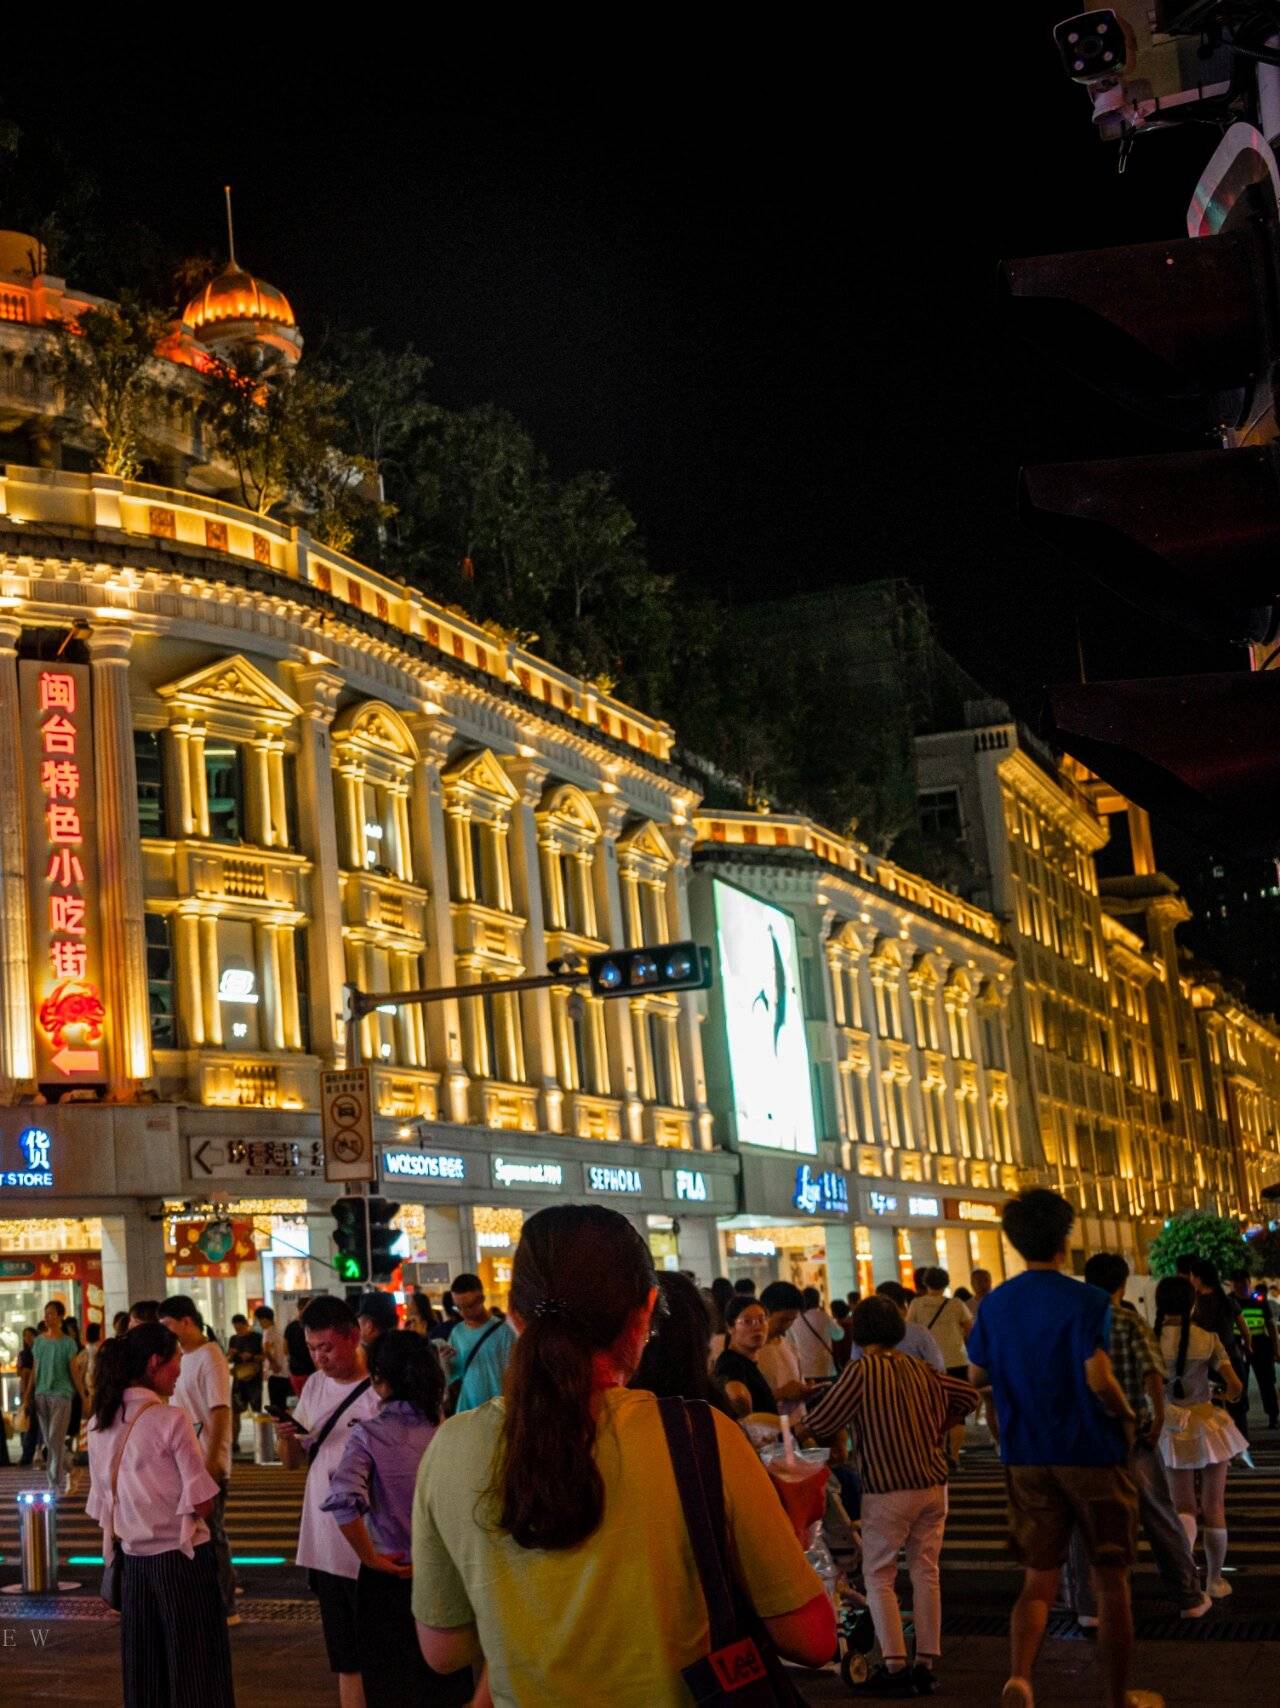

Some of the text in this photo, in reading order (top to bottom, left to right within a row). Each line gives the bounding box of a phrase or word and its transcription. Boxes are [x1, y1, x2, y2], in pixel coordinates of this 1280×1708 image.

[38, 671, 88, 981] 闽台特色小吃街
[7, 1173, 53, 1187] STORE
[590, 1166, 642, 1192] SEPHORA
